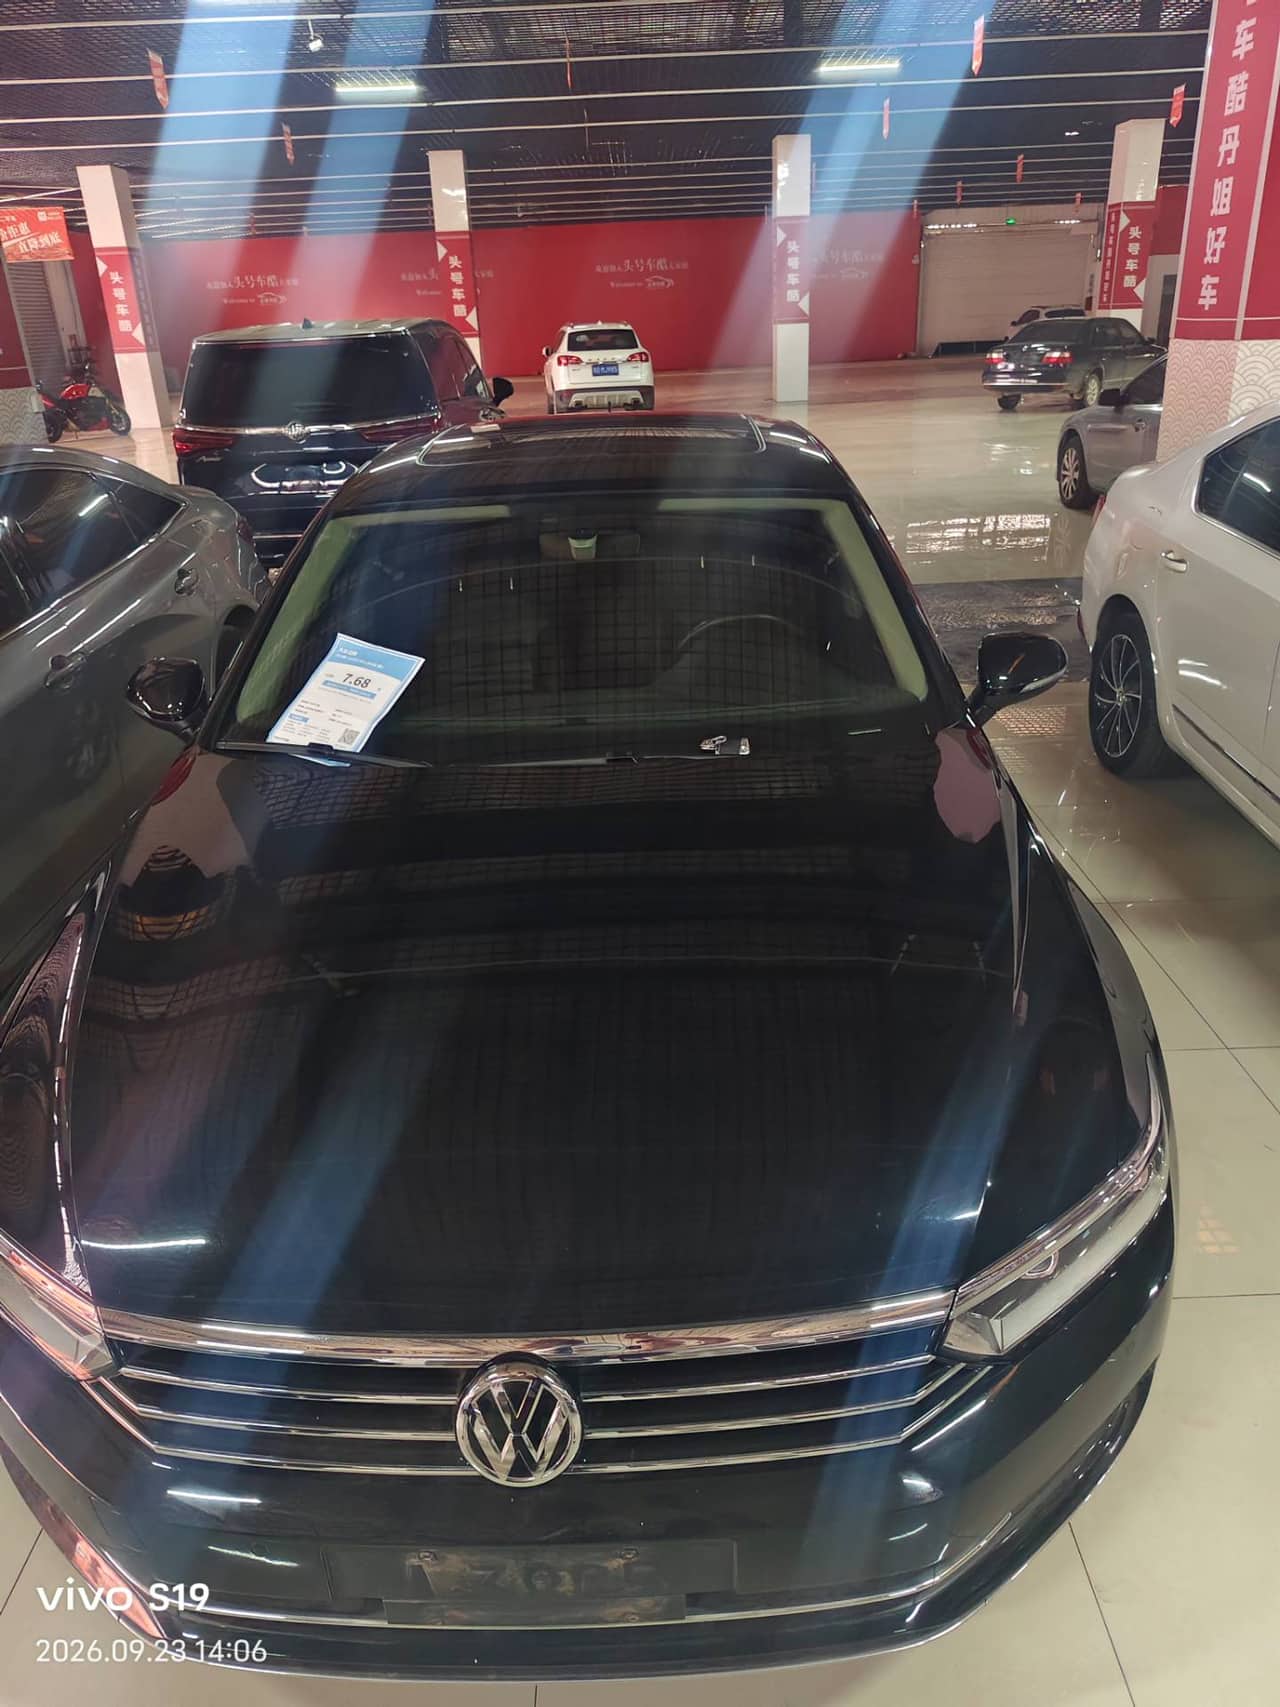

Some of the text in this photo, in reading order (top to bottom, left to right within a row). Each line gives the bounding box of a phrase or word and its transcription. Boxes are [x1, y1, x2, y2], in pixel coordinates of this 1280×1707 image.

[1197, 0, 1257, 311] 车酷丹姐好车
[18, 231, 63, 254] 直降到底
[786, 239, 801, 303] 头号车酷
[1123, 225, 1142, 288] 头号车酷
[109, 271, 133, 332] 头号车酷
[448, 255, 467, 317] 头号车酷
[341, 672, 372, 689] 7.68
